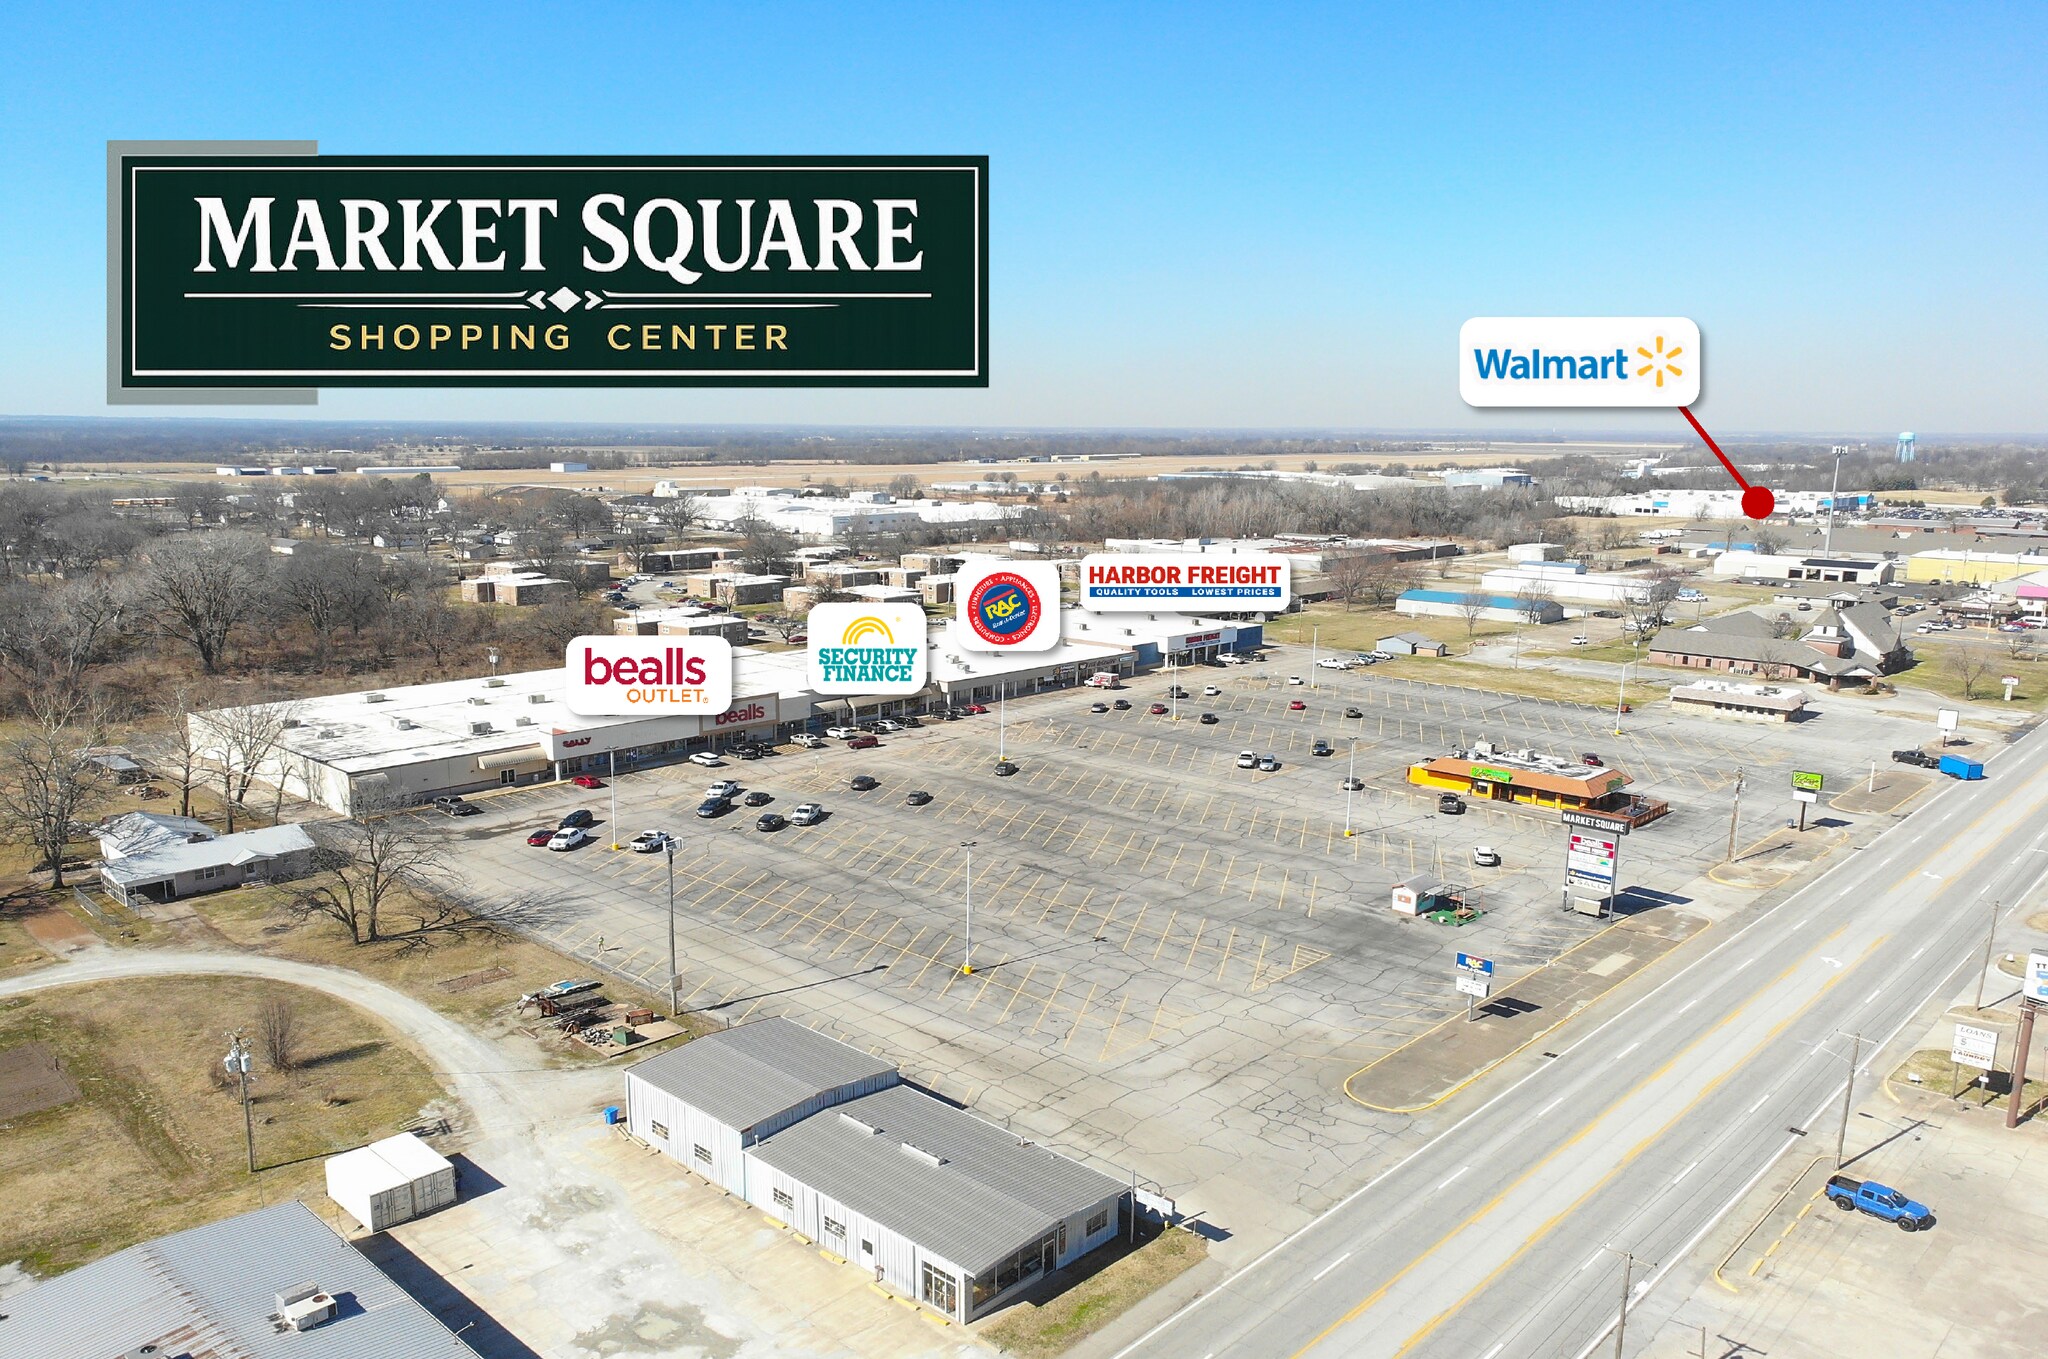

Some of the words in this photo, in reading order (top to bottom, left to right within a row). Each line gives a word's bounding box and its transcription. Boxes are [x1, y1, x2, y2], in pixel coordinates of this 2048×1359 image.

[715, 703, 765, 726] bealls
[1563, 813, 1595, 827] MARKET
[1595, 818, 1624, 832] SQUARE
[1960, 1026, 1992, 1039] LOANS
